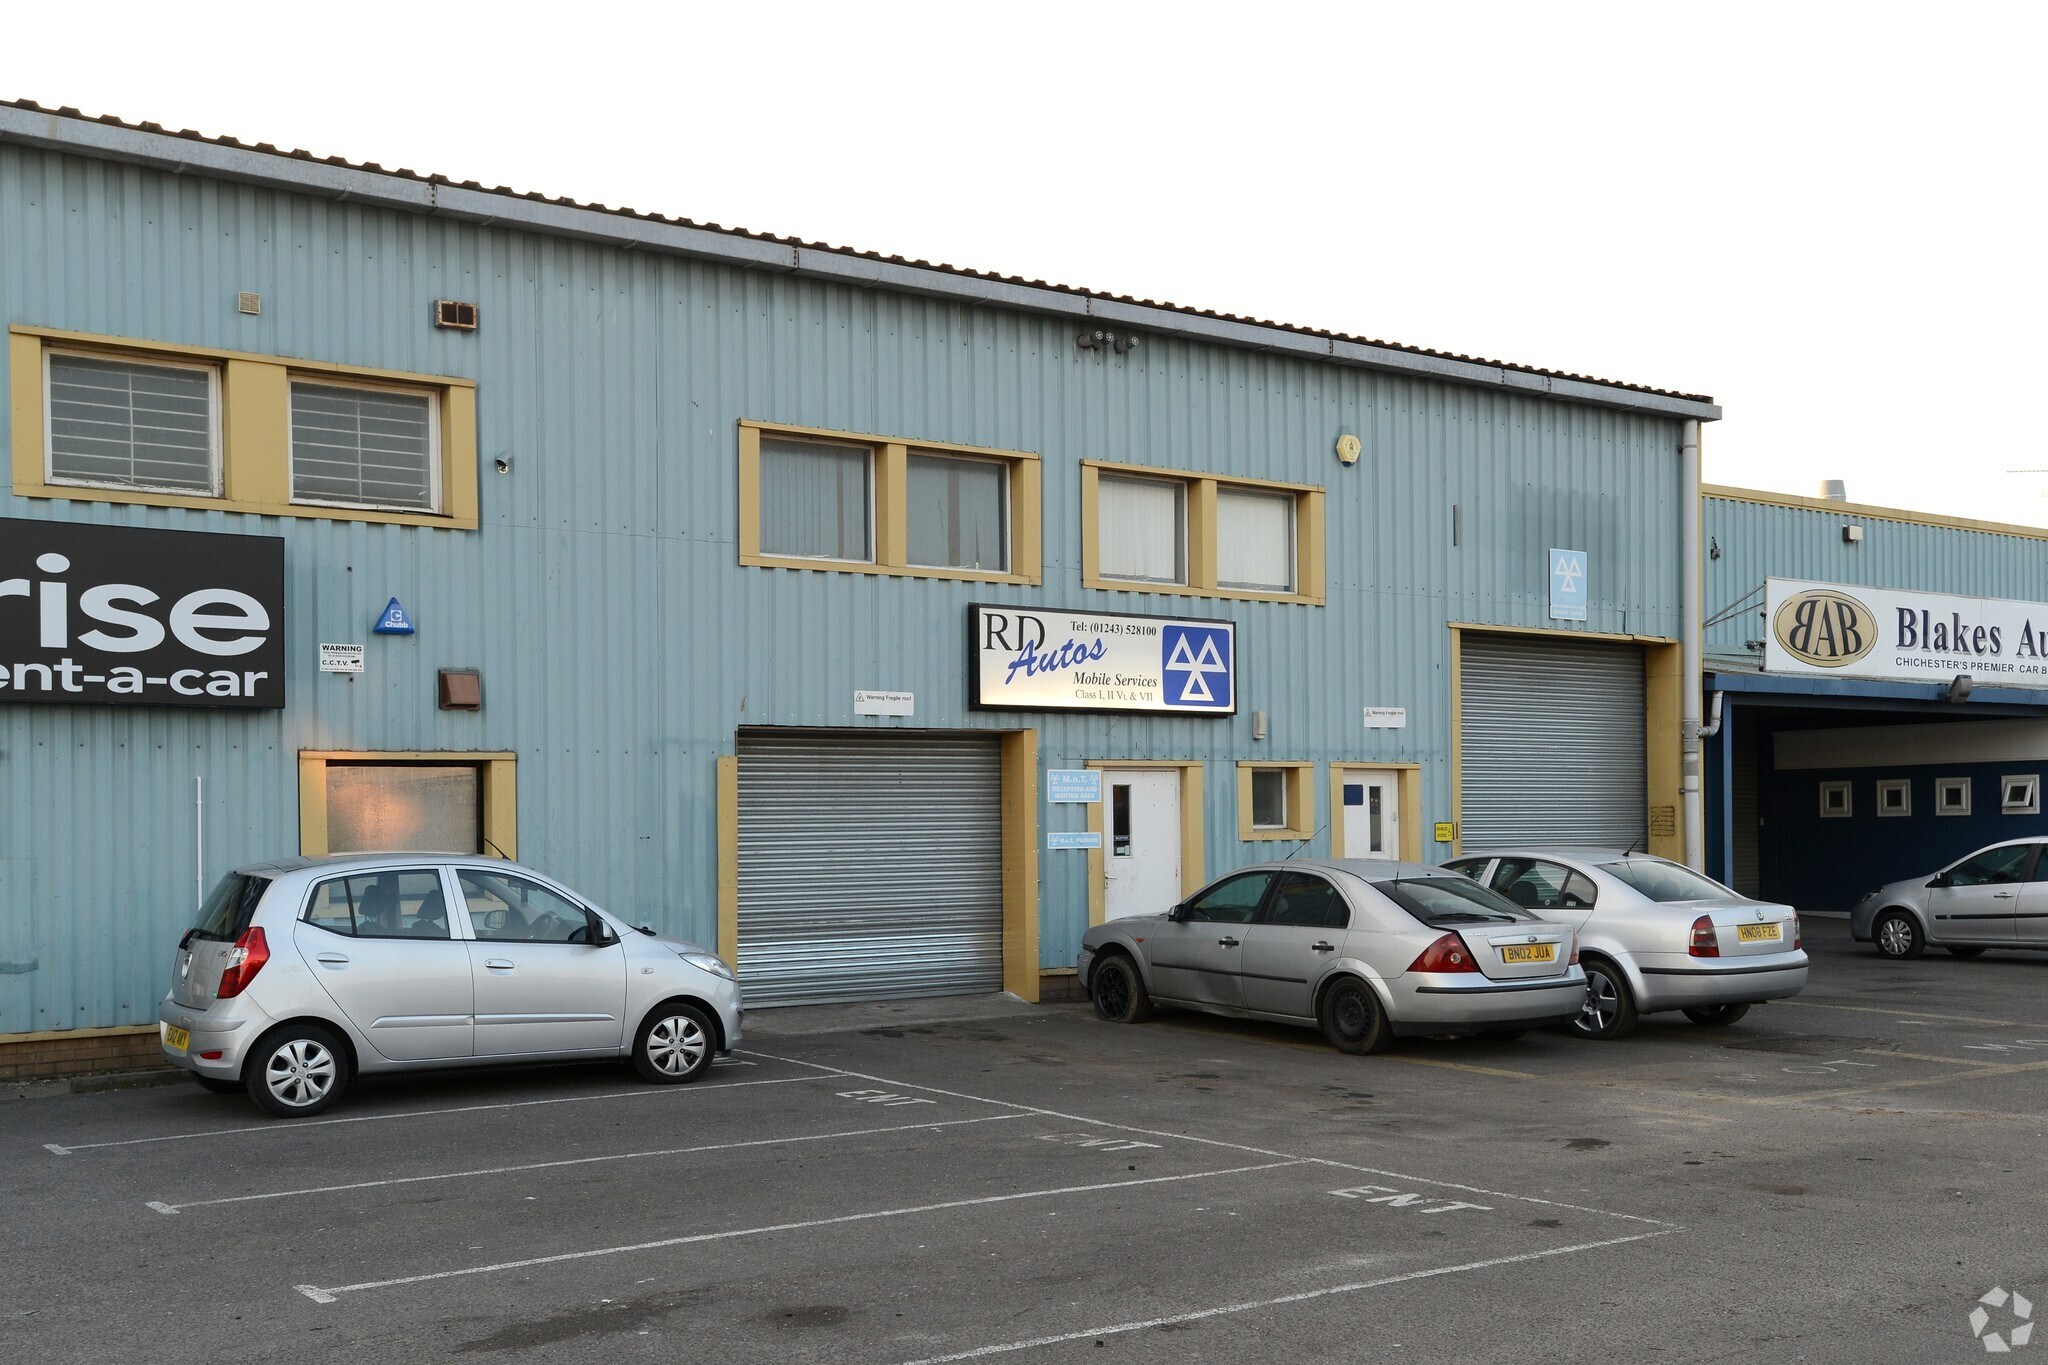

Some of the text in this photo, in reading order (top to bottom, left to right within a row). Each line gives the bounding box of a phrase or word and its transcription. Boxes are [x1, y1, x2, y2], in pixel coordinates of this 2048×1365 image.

[983, 613, 1045, 651] RD
[1070, 621, 1157, 636] Tel: (01243) 528100
[1896, 607, 2001, 654] Blakes
[1005, 638, 1108, 685] Autos
[1896, 657, 1968, 670] CHICHESTER'S
[1970, 662, 2014, 673] PREMIER
[2019, 665, 2038, 675] CAR
[1073, 671, 1157, 687] Mobile Services
[1075, 689, 1097, 699] Class
[1129, 692, 1137, 700] &
[1140, 692, 1153, 701] VII
[1741, 926, 1777, 938] HN08 FZE
[1509, 947, 1550, 960] BN02 JUA
[1326, 1185, 1495, 1214] ENT
